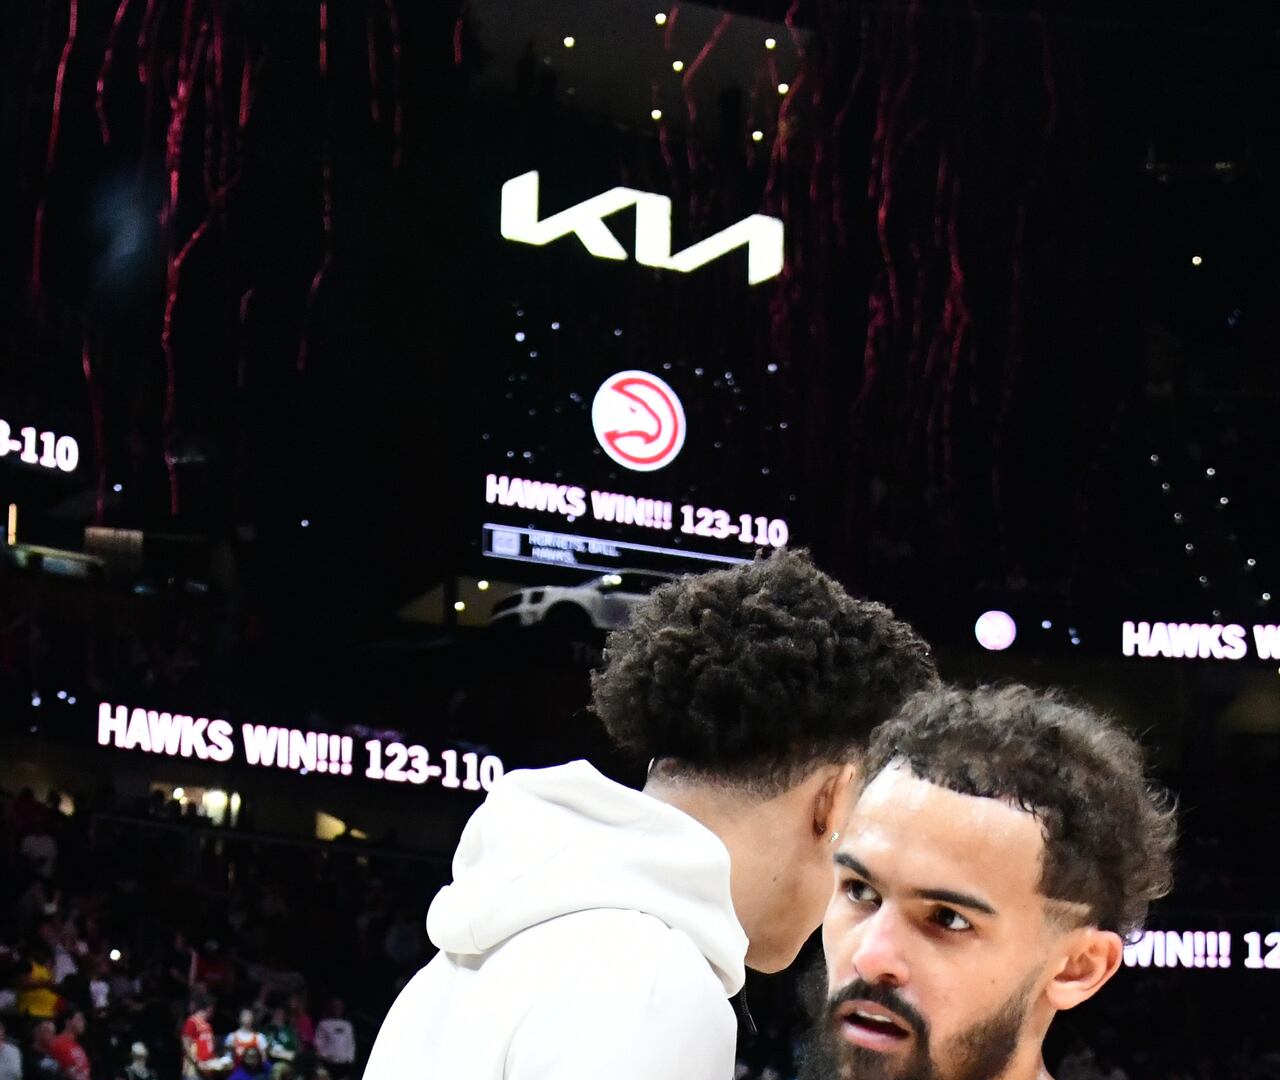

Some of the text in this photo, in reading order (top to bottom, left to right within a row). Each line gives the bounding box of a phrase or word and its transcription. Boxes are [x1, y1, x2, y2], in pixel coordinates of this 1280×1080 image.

[485, 473, 789, 547] HAWKS WIN!!! 123-110
[1122, 621, 1247, 661] HAWKS
[97, 702, 504, 792] HAWKS WIN!!! 123-110
[1123, 930, 1232, 968] WIN!!!
